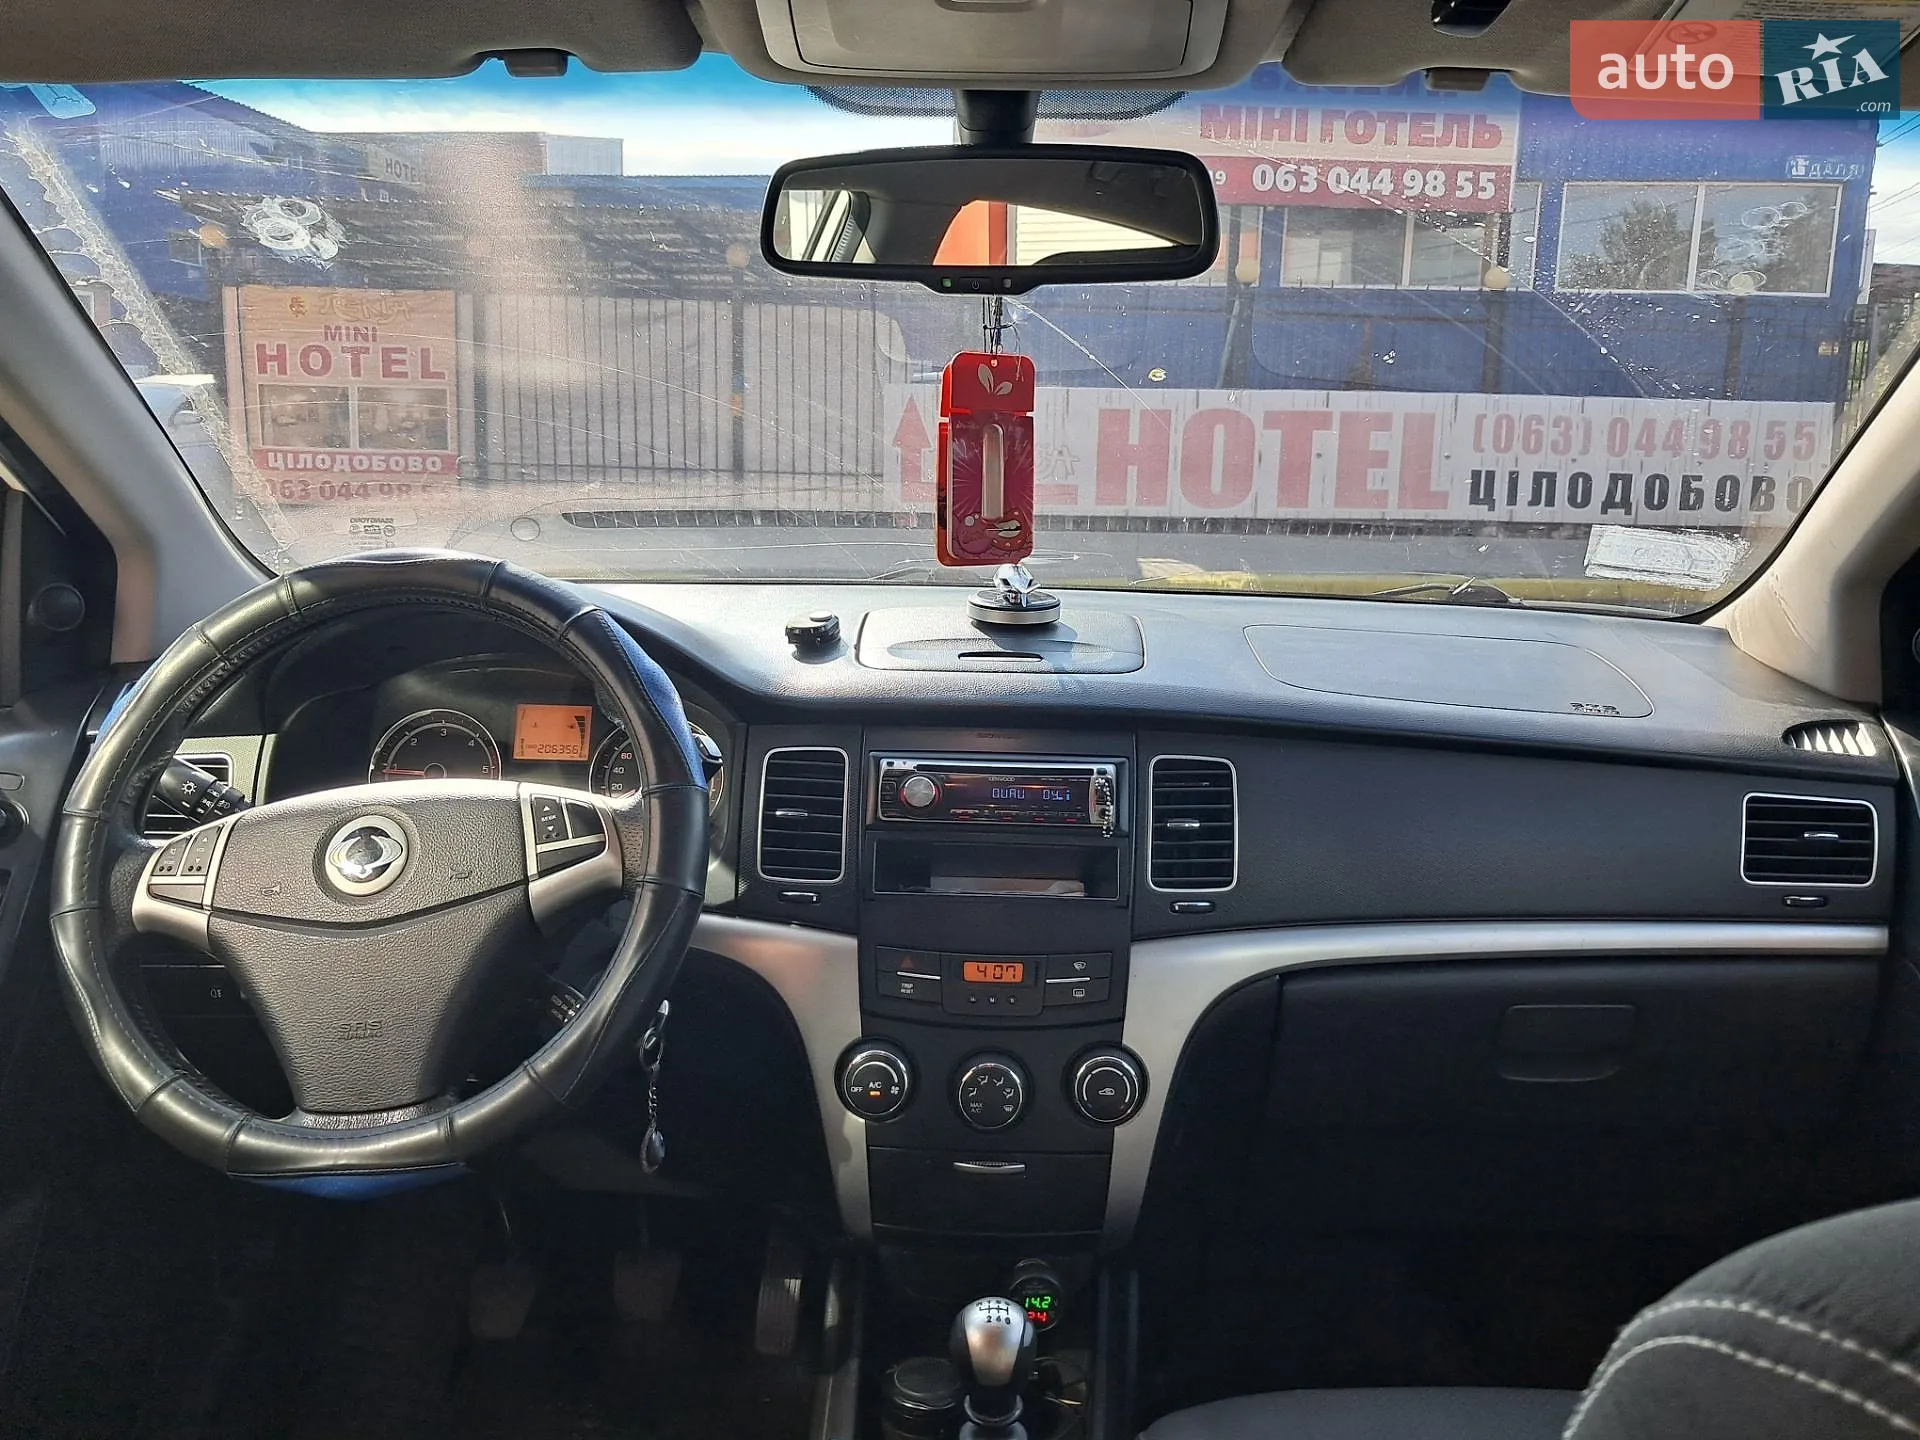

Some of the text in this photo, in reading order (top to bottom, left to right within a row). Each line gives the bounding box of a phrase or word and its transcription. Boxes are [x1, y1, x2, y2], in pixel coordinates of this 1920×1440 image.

[1200, 104, 1502, 149] МІНІ ГОТЕЛЬ
[1252, 163, 1318, 193] 063
[1327, 166, 1395, 196] 044
[1402, 169, 1446, 198] 98
[1455, 170, 1496, 200] 55
[323, 324, 378, 342] MINI
[255, 342, 447, 380] HOTEL
[1472, 412, 1817, 461] (063) 044 98 55
[267, 452, 442, 472] ЦІЛОДОБОВО
[1095, 408, 1450, 511] HOTEL
[1468, 468, 1815, 516] ЦІЛОДОБОВО
[440, 728, 447, 737] 3
[410, 738, 418, 746] 2
[467, 739, 475, 747] 4
[537, 743, 579, 755] 206356
[481, 765, 489, 774] 5
[612, 766, 625, 774] 40
[611, 783, 623, 791] 20
[1025, 1296, 1051, 1308] 14.2
